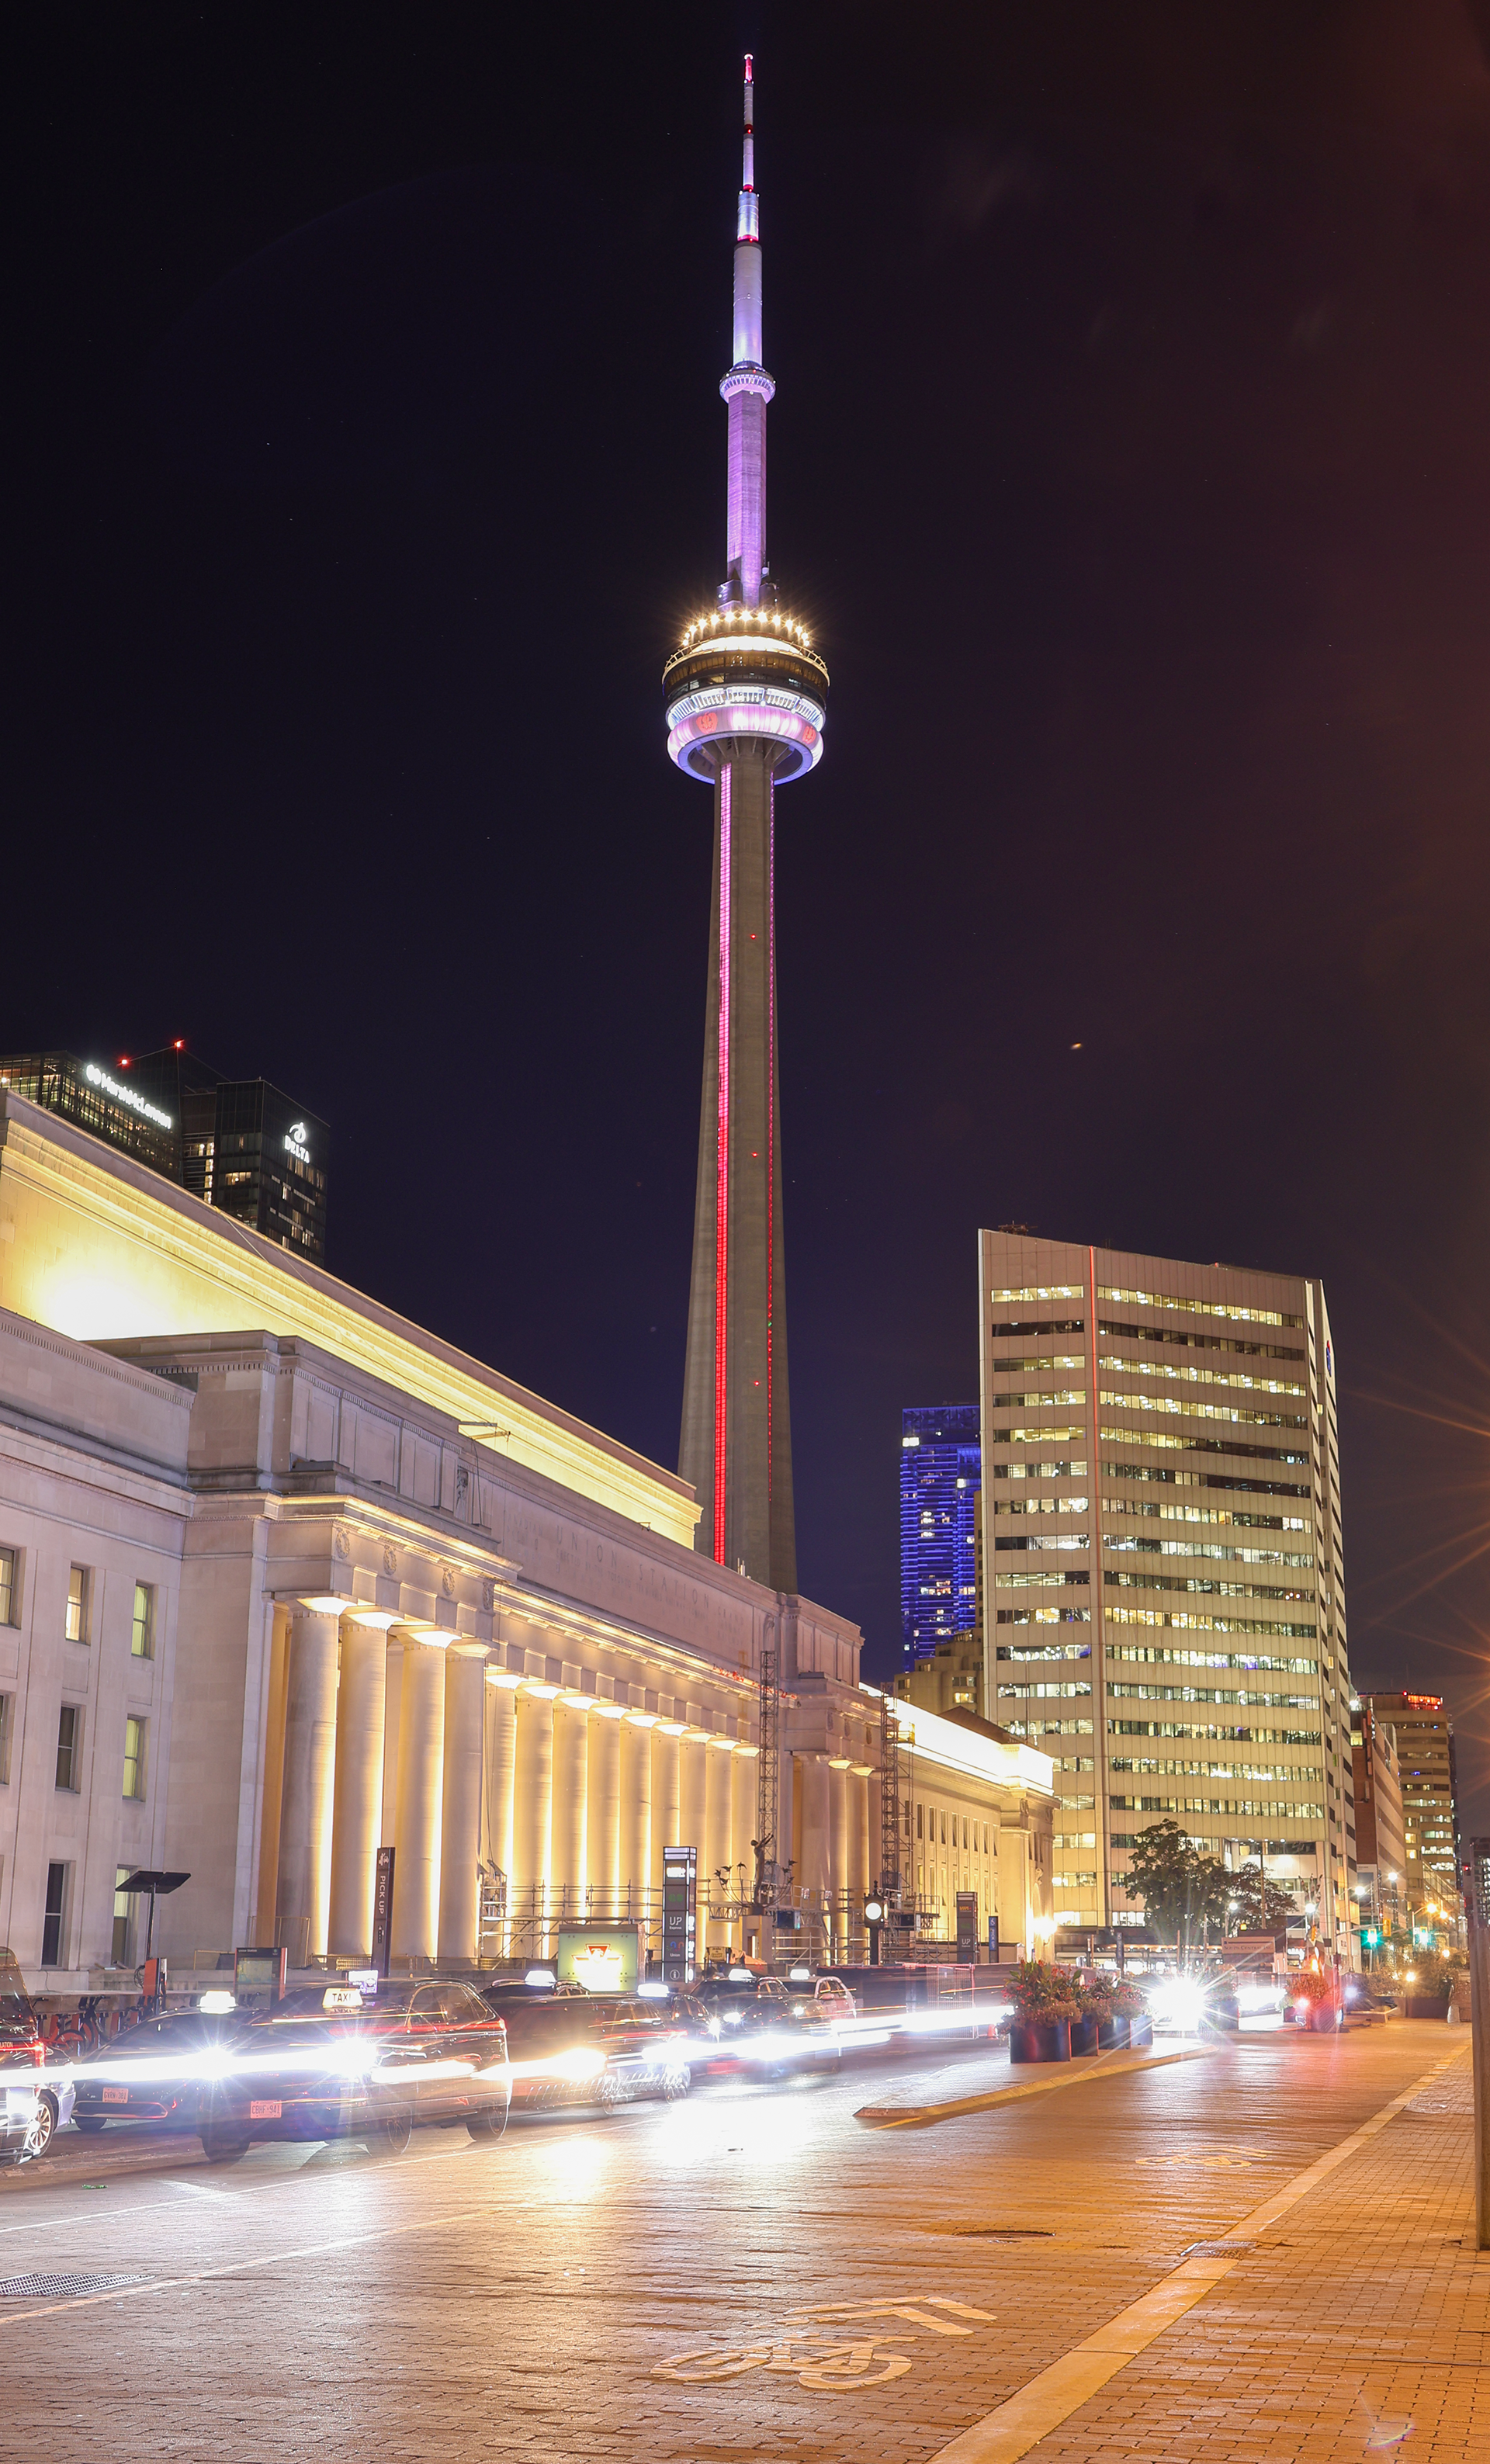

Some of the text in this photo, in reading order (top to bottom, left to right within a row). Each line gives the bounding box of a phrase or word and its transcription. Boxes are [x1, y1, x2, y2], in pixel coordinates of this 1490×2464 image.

[284, 1135, 310, 1163] DELTA
[556, 1524, 617, 1568] UNION
[639, 1563, 709, 1610] STATION
[378, 1901, 385, 1915] UP
[669, 1916, 682, 1925] UP
[332, 1993, 352, 2002] TAXI
